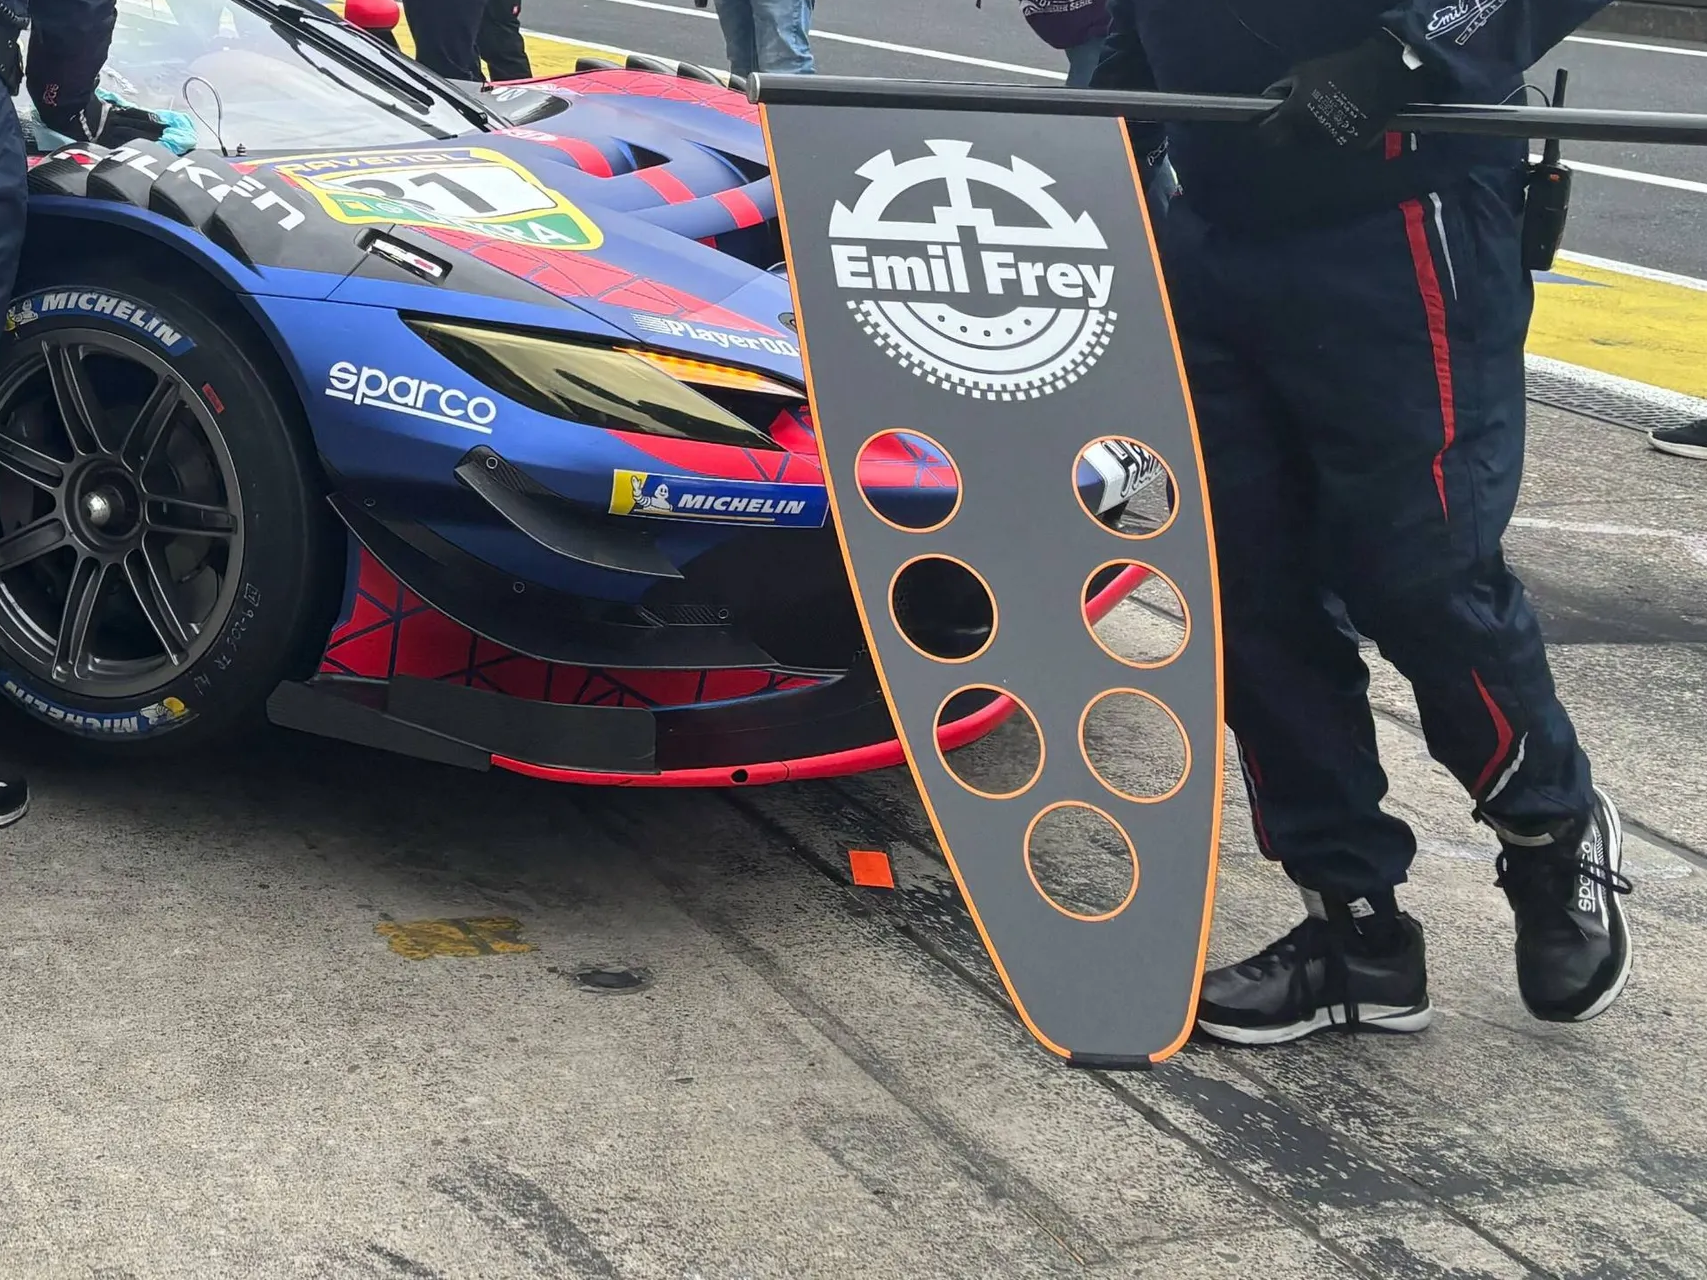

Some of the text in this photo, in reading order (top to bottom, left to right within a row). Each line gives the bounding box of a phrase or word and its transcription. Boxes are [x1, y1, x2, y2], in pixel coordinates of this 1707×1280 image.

[831, 244, 1115, 308] Emil Frey
[41, 292, 182, 347] MICHELIN
[326, 360, 497, 434] sparco
[678, 493, 807, 515] MICHELIN
